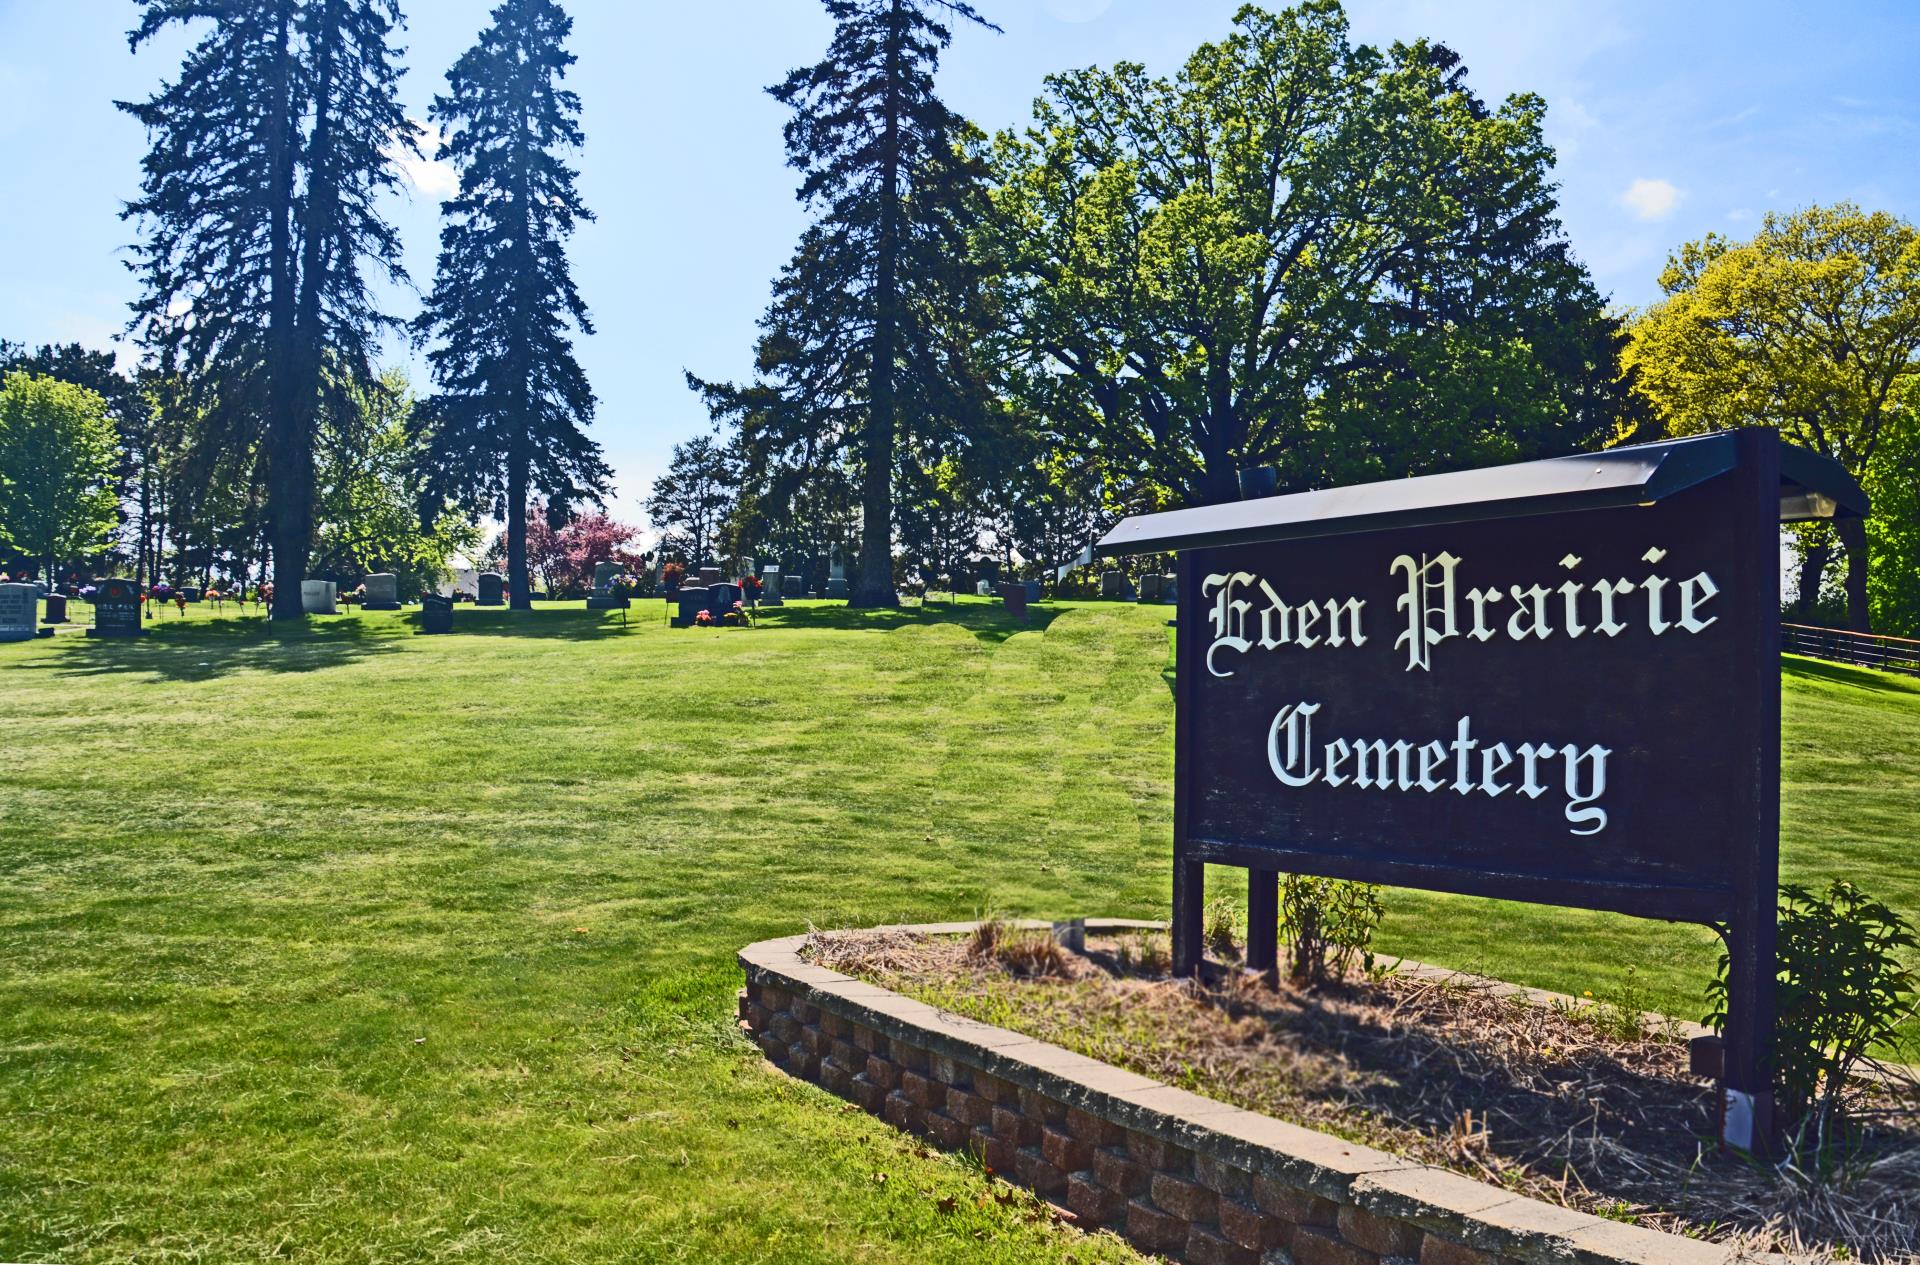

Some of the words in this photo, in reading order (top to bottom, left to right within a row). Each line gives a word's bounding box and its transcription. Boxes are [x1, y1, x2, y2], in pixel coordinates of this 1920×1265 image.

[1201, 571, 1367, 677] Eden
[1389, 546, 1720, 672] Prairie
[1267, 701, 1612, 836] Cemetery
